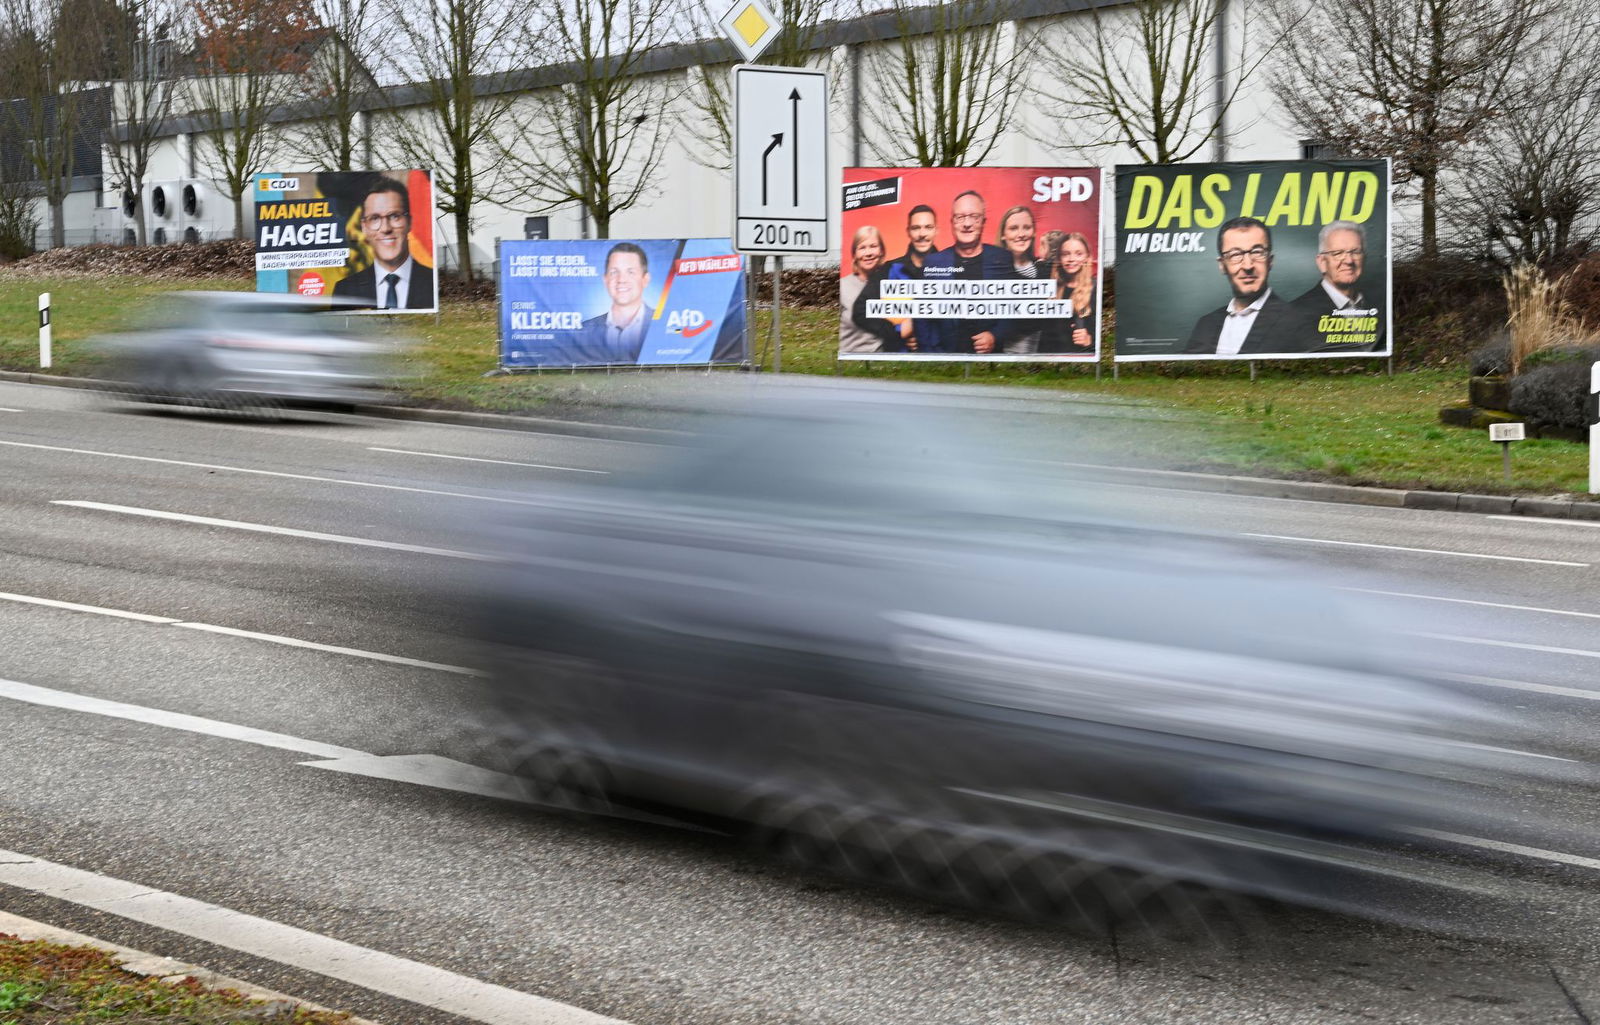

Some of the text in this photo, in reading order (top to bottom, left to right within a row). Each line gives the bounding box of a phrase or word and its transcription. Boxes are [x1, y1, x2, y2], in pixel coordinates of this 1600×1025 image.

[271, 180, 296, 189] CDU
[1032, 175, 1093, 202] SPD
[1124, 171, 1378, 229] DAS LAND
[260, 202, 333, 220] MANUEL
[261, 222, 344, 247] HAGEL
[753, 223, 811, 245] 200 m
[1125, 232, 1206, 253] IM BLICK.
[510, 255, 538, 266] LASST
[540, 255, 555, 266] SIE
[679, 256, 738, 274] AFD WÄHLEN!
[510, 266, 538, 277] LASST
[540, 266, 558, 277] UNS
[883, 283, 1053, 296] WEIL ES UM DICH GEHT,
[666, 308, 705, 327] AfD
[870, 303, 1069, 315] WENN ES UM POLITIK GEHT.
[511, 311, 583, 330] KLECKER
[1318, 315, 1378, 332] ÖZDEMIR
[1326, 334, 1342, 343] DER
